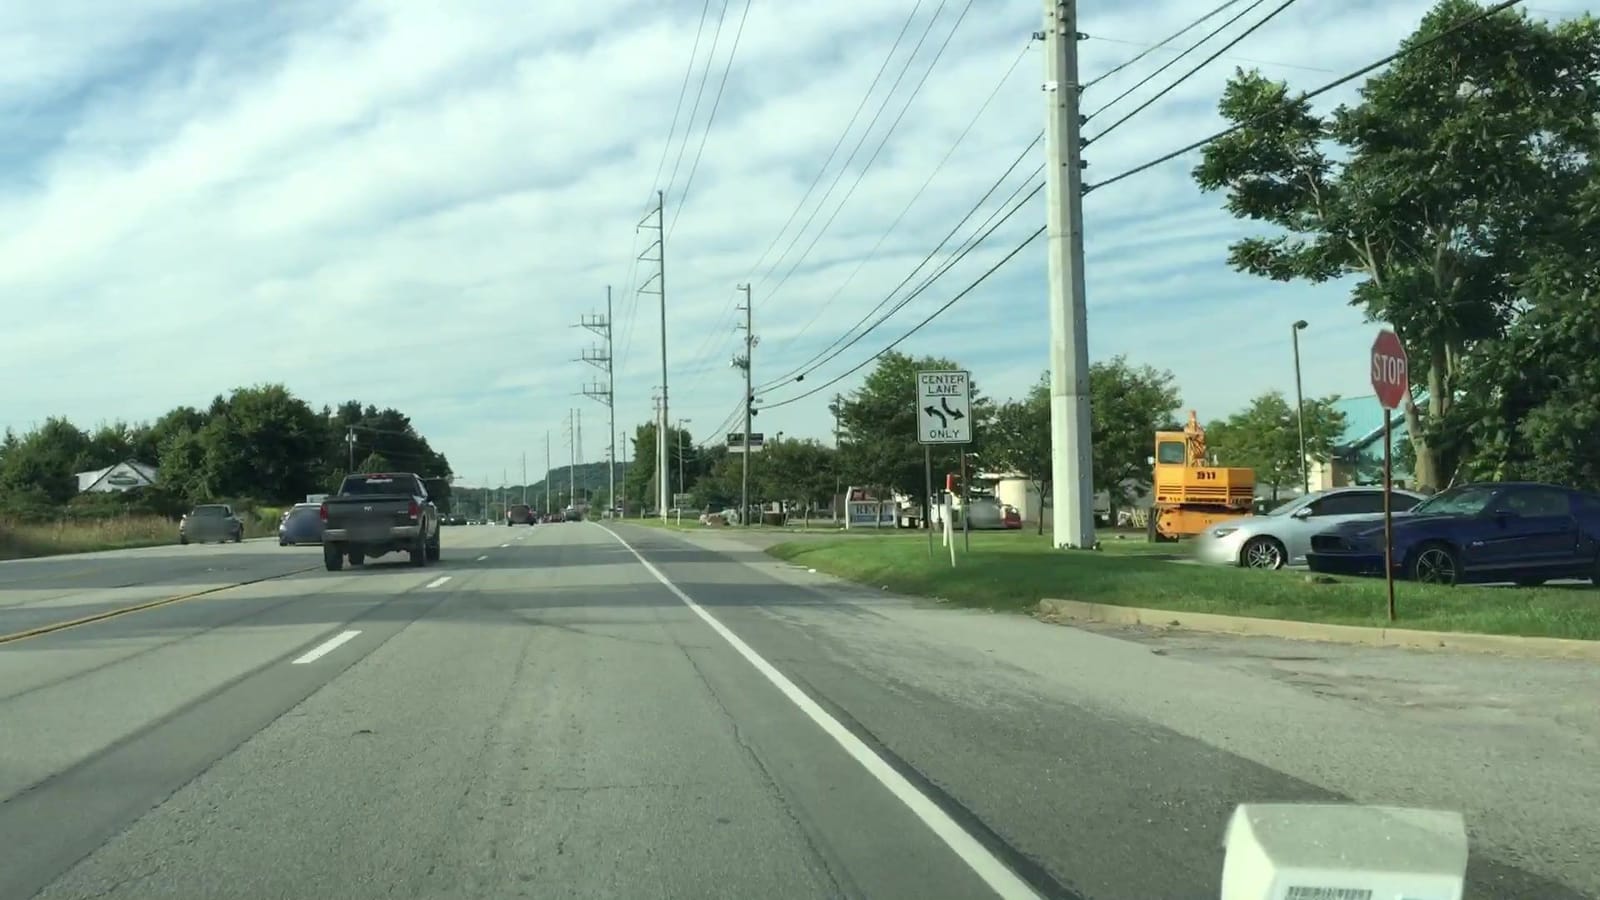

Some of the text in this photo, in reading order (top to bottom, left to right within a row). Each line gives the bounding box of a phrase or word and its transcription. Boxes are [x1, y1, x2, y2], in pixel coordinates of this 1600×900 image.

[1374, 353, 1405, 385] STOP
[921, 374, 964, 384] CENTER
[928, 384, 958, 394] LANE
[929, 429, 960, 439] ONLY
